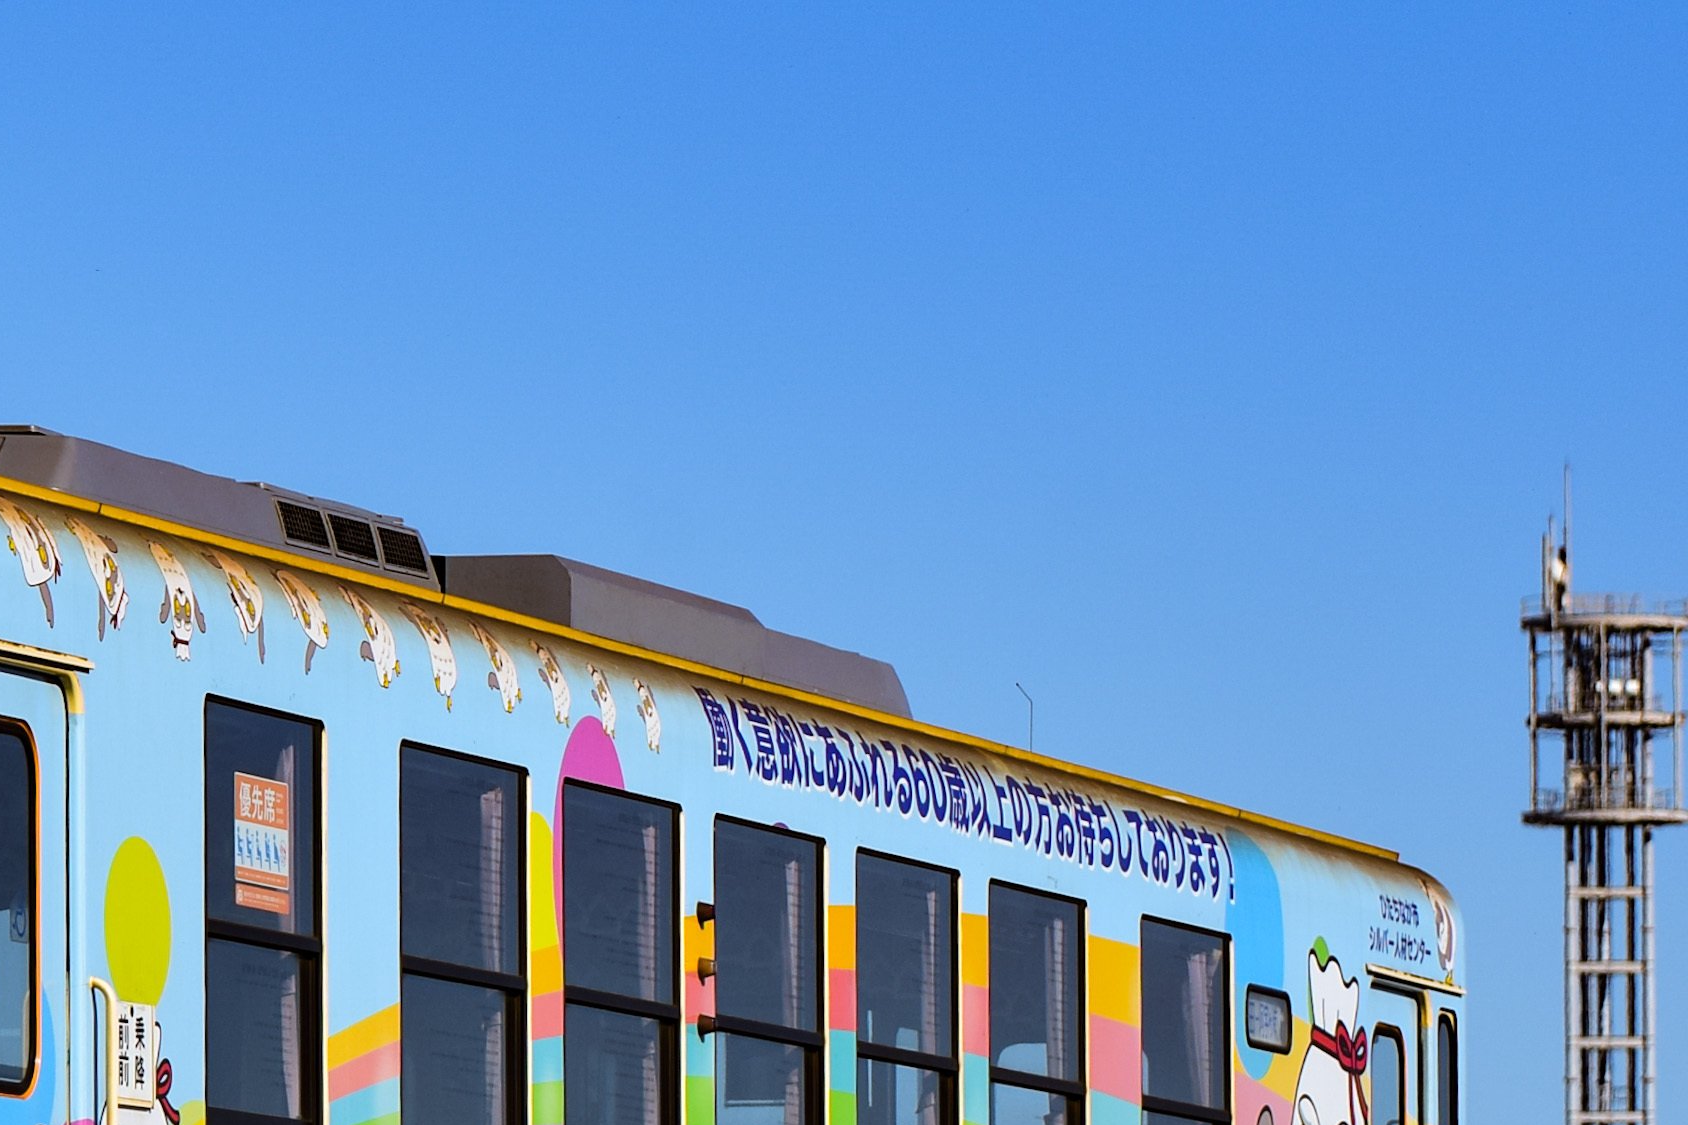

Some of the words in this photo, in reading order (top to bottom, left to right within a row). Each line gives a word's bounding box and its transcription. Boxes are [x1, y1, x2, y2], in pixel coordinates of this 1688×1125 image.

[239, 782, 276, 822] 優先席
[1369, 926, 1431, 964] シルバー人材センター
